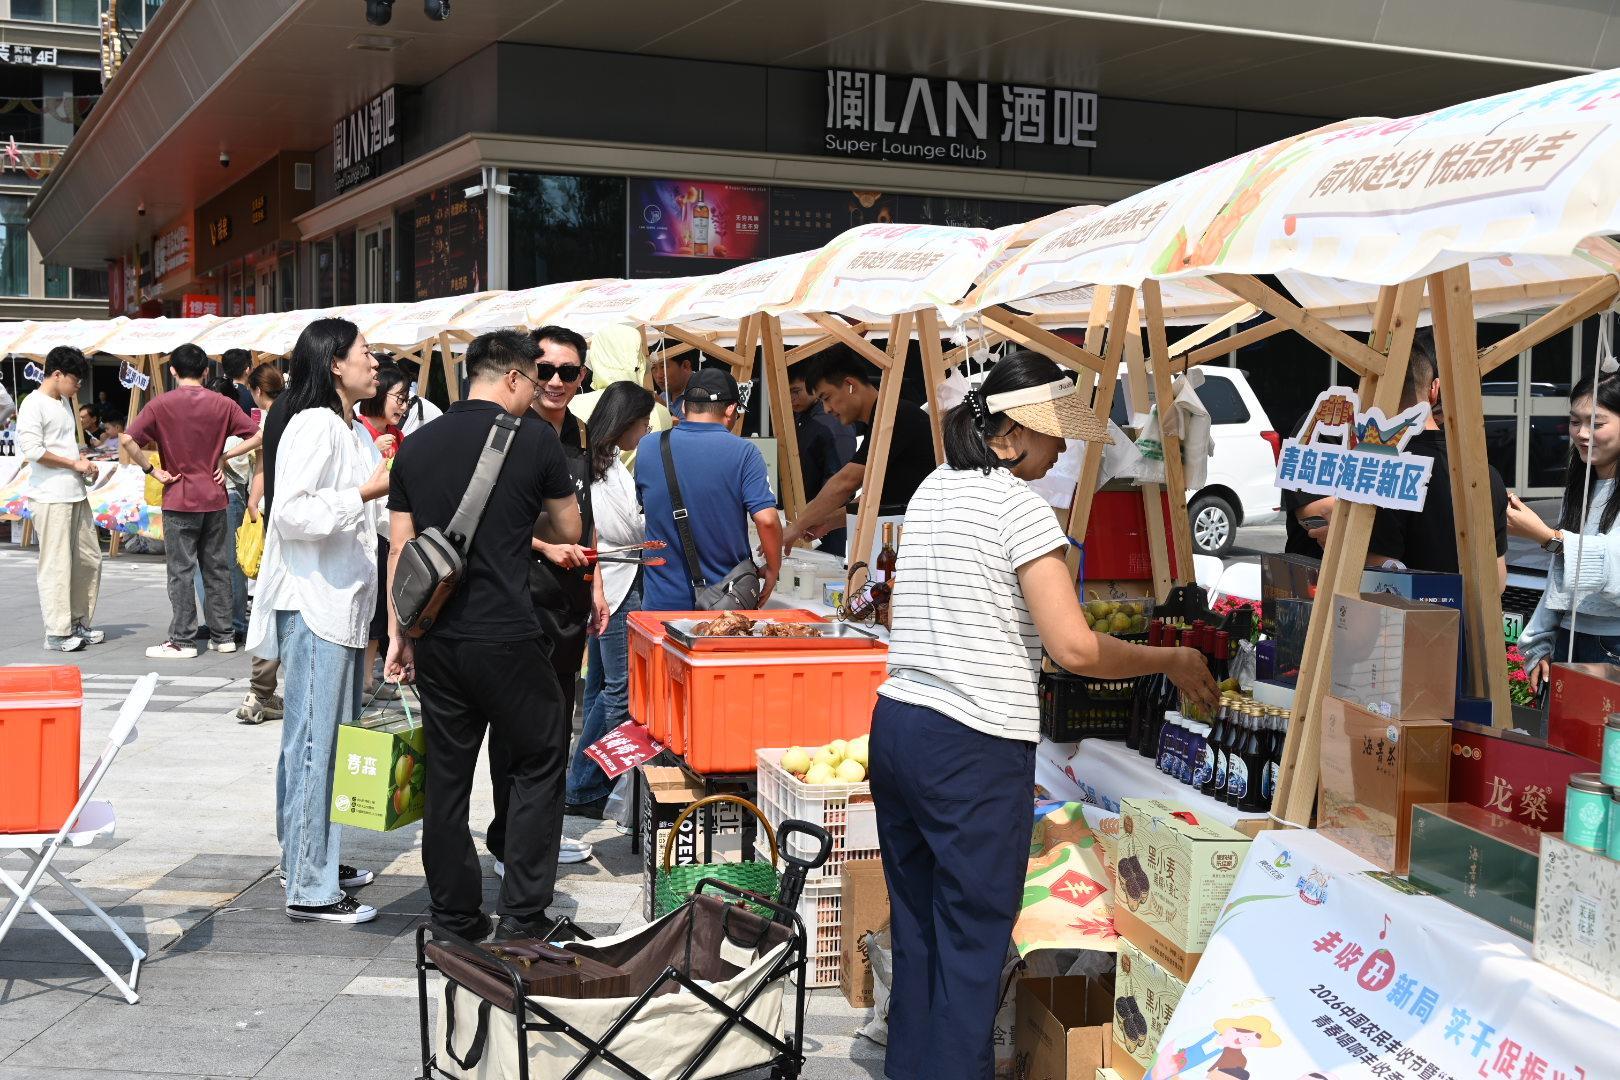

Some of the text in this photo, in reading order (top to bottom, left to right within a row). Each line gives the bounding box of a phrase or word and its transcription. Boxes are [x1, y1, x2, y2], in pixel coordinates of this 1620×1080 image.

[825, 134, 987, 161] Super Lounge Club
[1309, 130, 1578, 199] 荷风赴约 悦品秋丰
[1279, 446, 1425, 502] 青岛西海岸新区
[1312, 930, 1440, 1025] 丰收开新局
